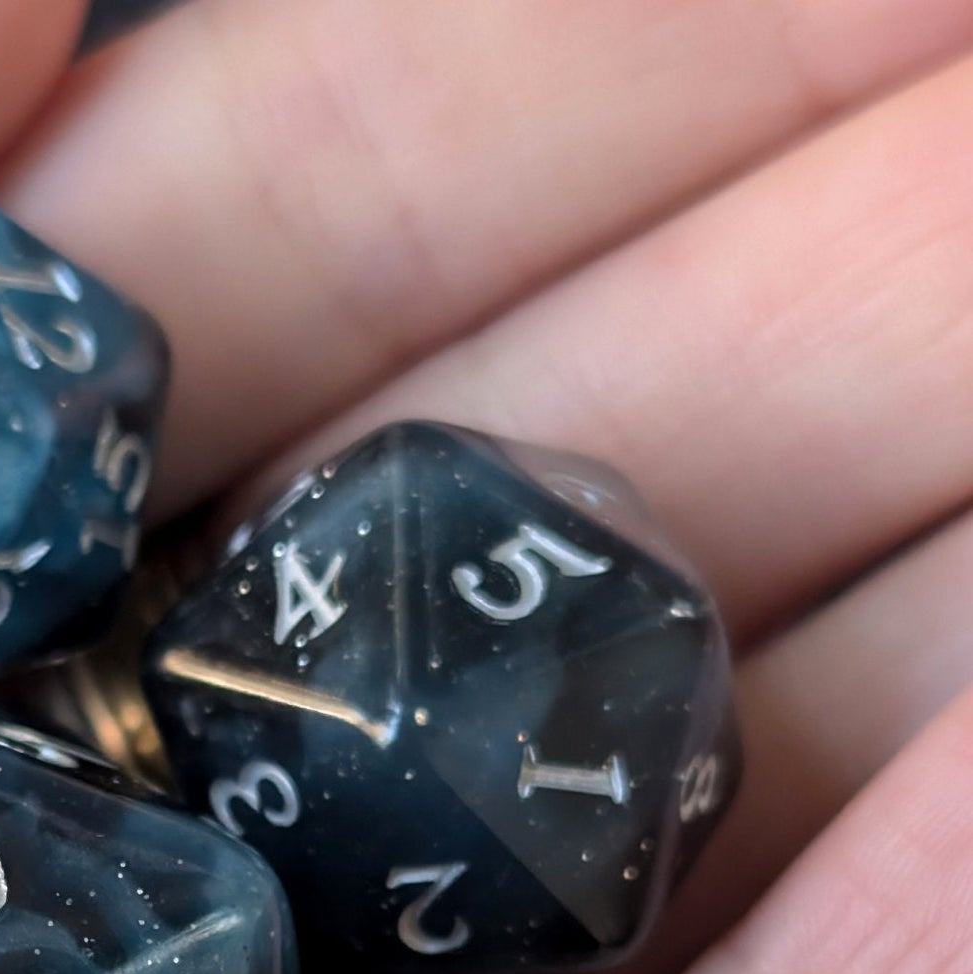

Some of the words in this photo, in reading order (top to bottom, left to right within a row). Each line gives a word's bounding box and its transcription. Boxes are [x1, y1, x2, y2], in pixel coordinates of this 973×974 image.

[272, 542, 347, 646] 4
[450, 524, 613, 622] 5
[209, 759, 301, 837] 3
[517, 744, 628, 806] 1
[386, 862, 471, 955] 2
